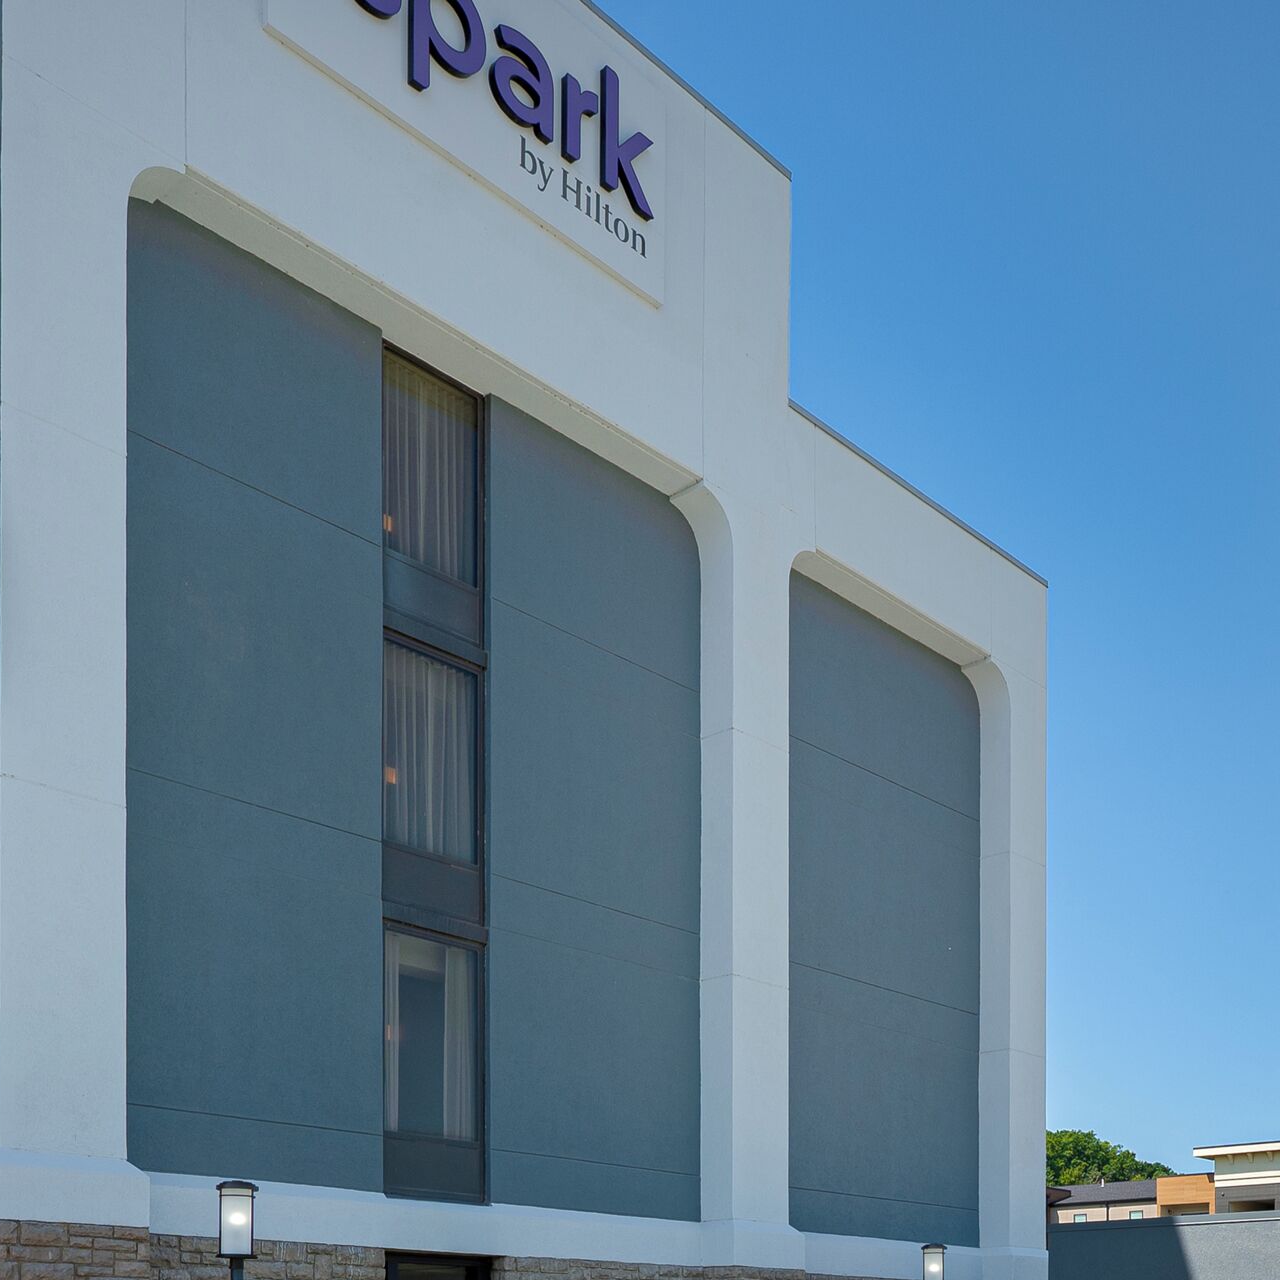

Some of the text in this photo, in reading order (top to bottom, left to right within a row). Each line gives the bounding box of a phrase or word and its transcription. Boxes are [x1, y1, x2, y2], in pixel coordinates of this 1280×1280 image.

[355, 0, 654, 222] park
[519, 134, 647, 259] by Hilton
